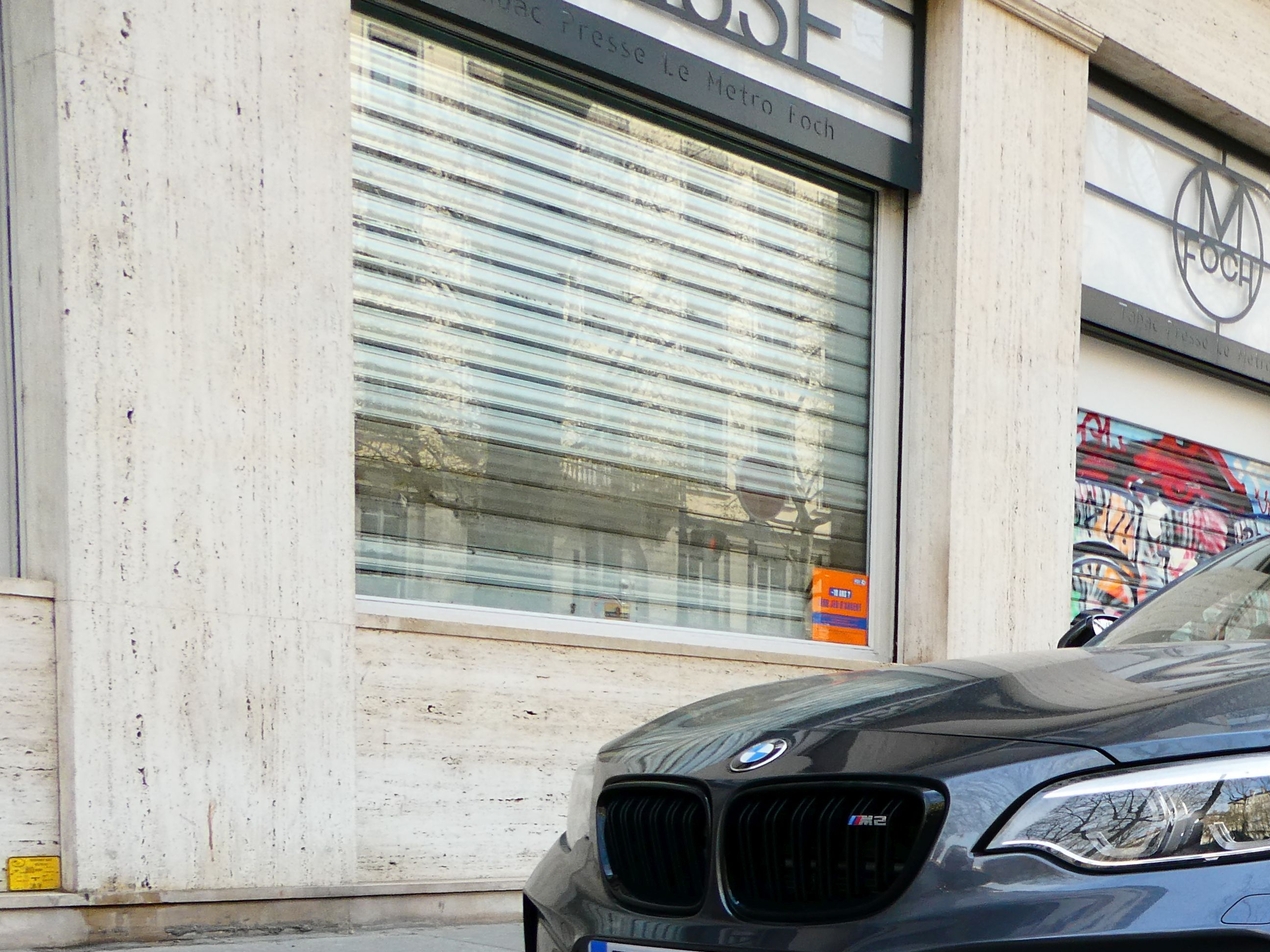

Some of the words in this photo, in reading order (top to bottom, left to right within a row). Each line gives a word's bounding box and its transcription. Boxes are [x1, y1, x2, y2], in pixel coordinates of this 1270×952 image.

[561, 10, 646, 65] Presse
[663, 52, 690, 82] Le
[707, 71, 774, 116] Metro
[788, 103, 835, 141] Foch
[1182, 228, 1254, 298] FOCH
[858, 815, 887, 826] M2
